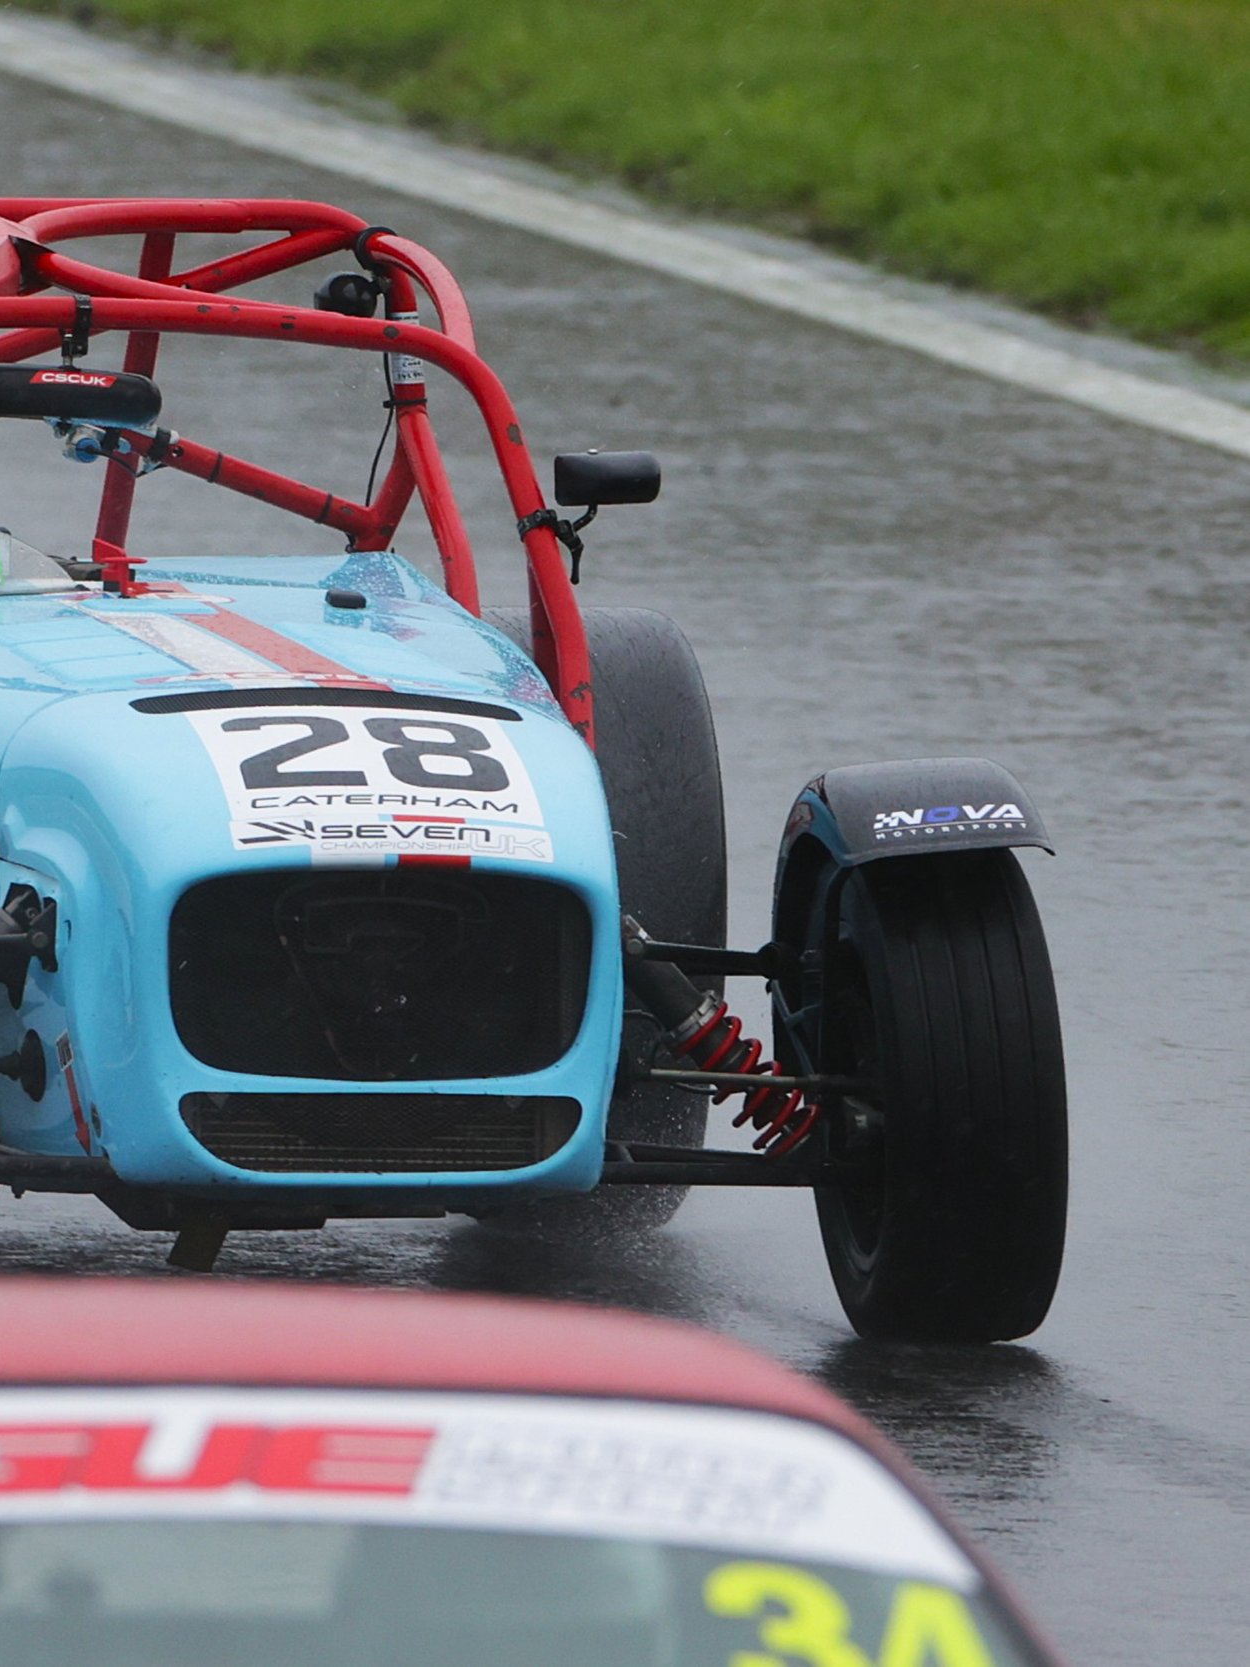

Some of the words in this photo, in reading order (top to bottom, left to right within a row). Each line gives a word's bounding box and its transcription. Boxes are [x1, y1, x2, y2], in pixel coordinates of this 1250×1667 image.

[41, 373, 107, 386] CSCUK
[221, 715, 511, 792] 28
[251, 794, 519, 814] CATERHAM
[886, 803, 1025, 827] NOVA
[875, 823, 1027, 840] MOTORSPORT
[319, 841, 471, 852] CHAMPIONSHIP
